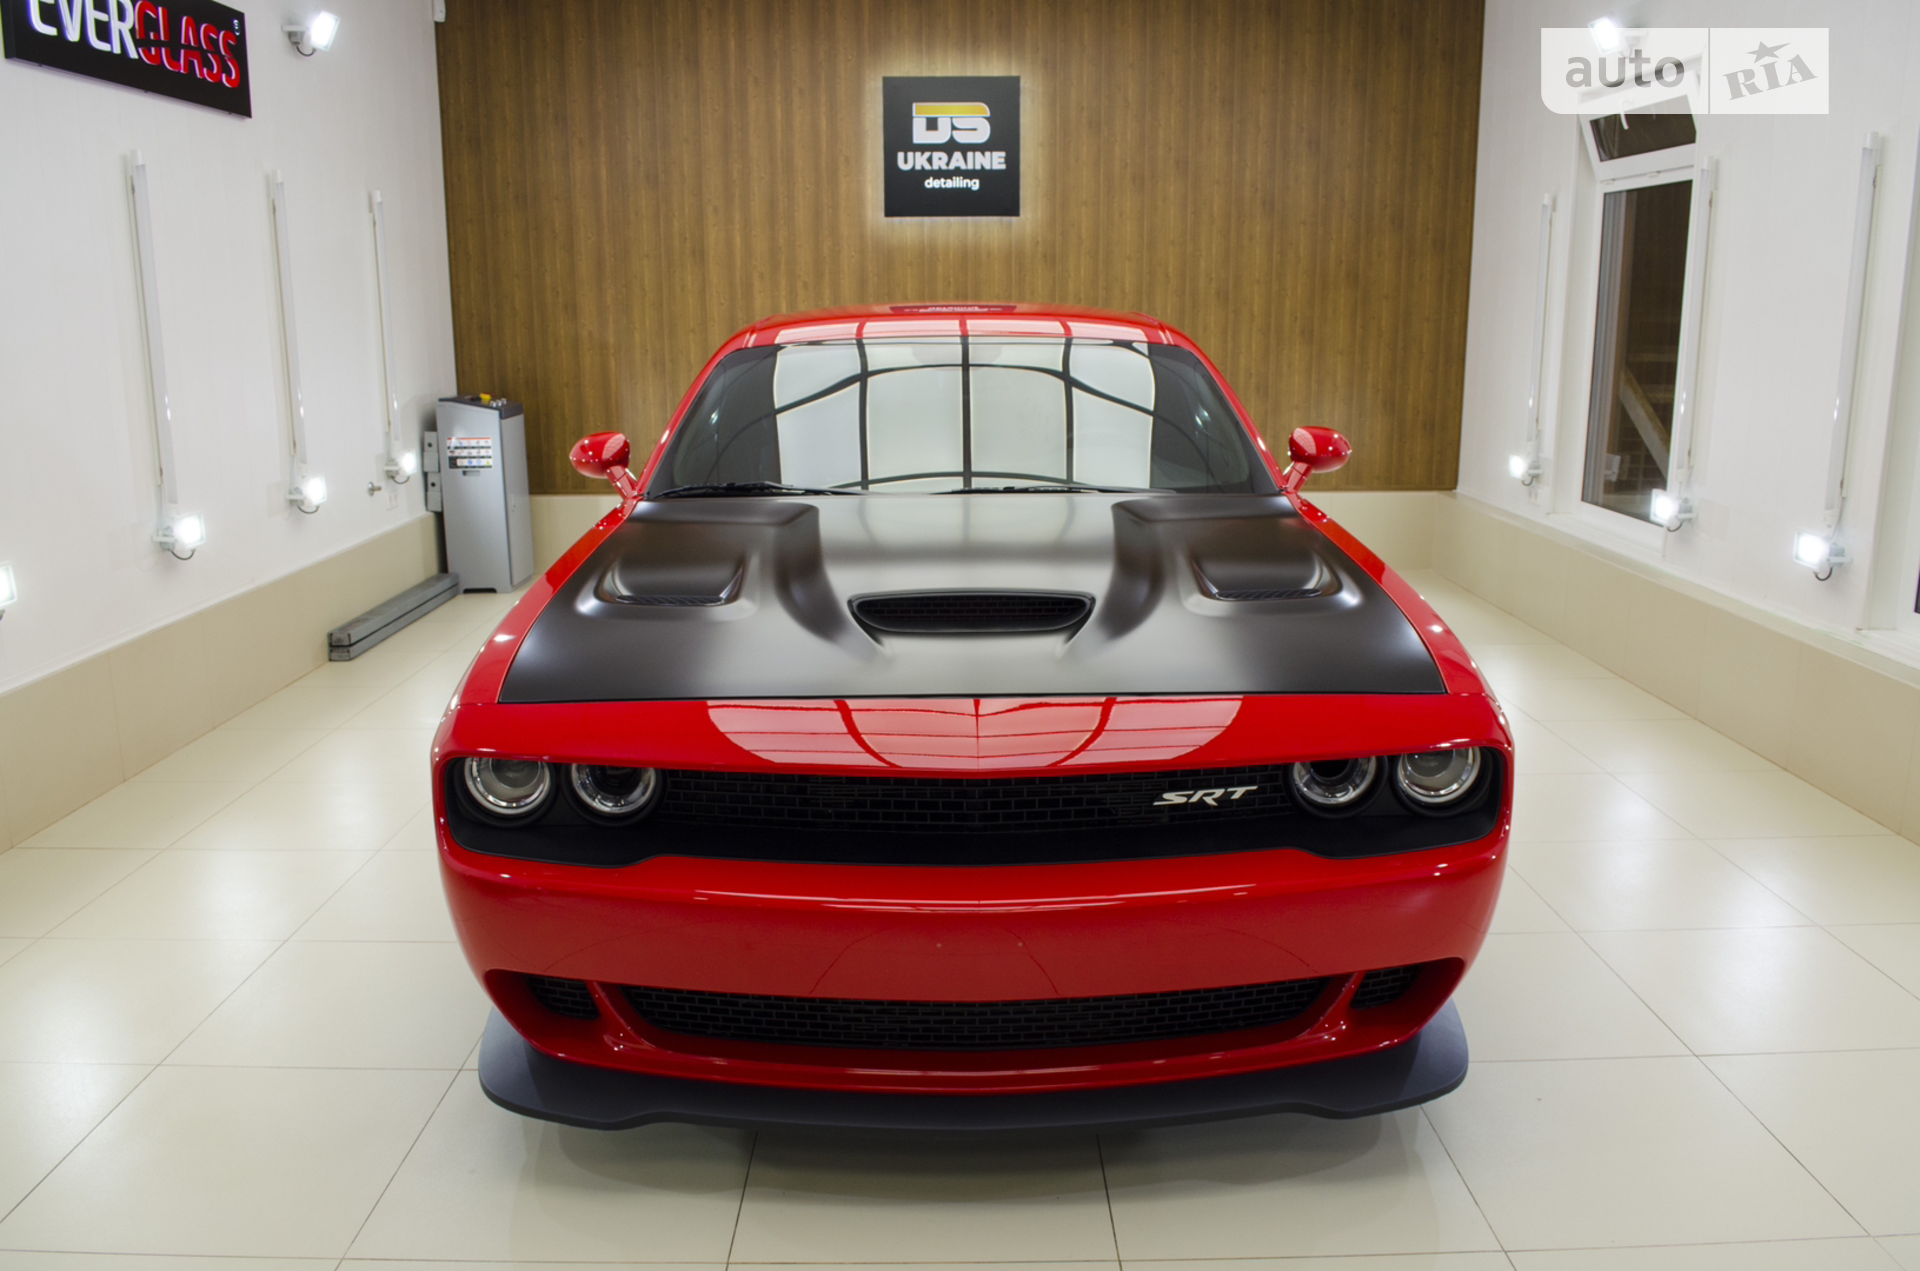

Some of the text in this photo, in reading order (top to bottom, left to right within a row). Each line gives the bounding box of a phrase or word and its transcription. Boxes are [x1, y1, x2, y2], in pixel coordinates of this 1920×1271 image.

[912, 101, 991, 144] DS
[896, 150, 1007, 171] UKRAINE
[924, 176, 980, 191] detailing
[1153, 785, 1259, 806] SRT
